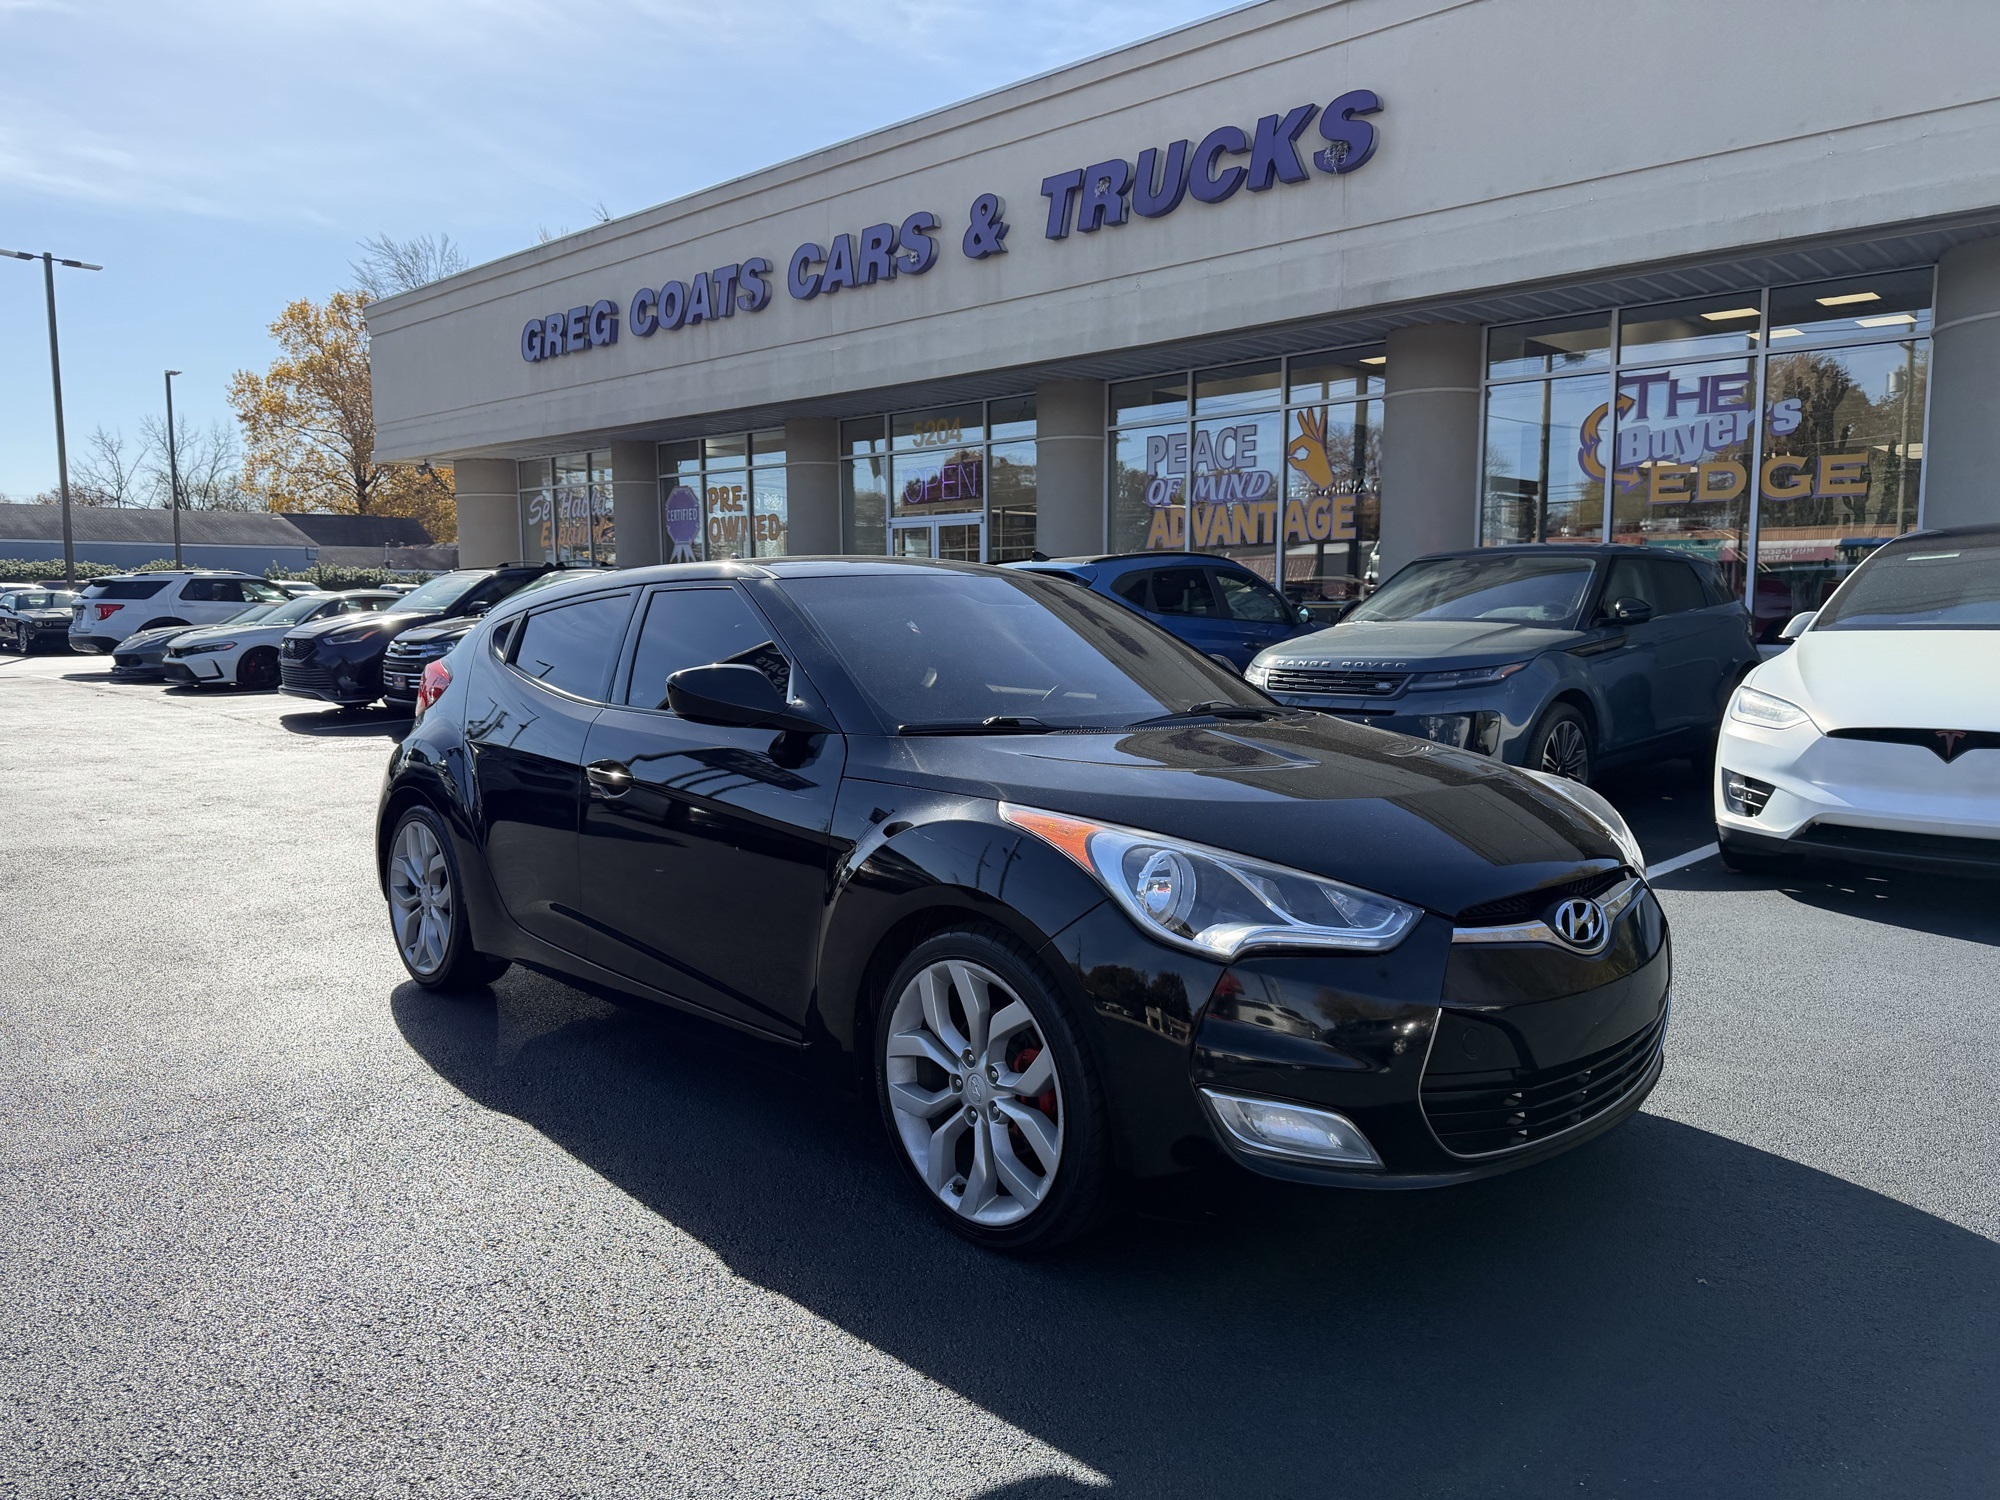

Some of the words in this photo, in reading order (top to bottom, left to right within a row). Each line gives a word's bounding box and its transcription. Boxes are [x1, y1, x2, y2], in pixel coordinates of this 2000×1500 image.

[521, 299, 619, 362] GREG
[630, 257, 773, 337] COATS
[788, 211, 941, 299] CARS
[962, 192, 1010, 260] &
[1041, 89, 1384, 240] TRUCKS
[1618, 370, 1750, 422] THE
[912, 416, 963, 448] 5204
[1146, 424, 1258, 476] PEACE
[1616, 398, 1803, 470] Buyer's
[903, 462, 977, 504] OPEN
[1146, 477, 1183, 507] OF
[1191, 469, 1273, 505] MIND
[1648, 452, 1871, 505] EDGE
[528, 494, 551, 526] Se
[666, 508, 698, 522] CERTIFIED
[708, 513, 780, 544] OWNED
[1146, 494, 1358, 550] ADVANTAGE
[1276, 659, 1331, 667] RANGE
